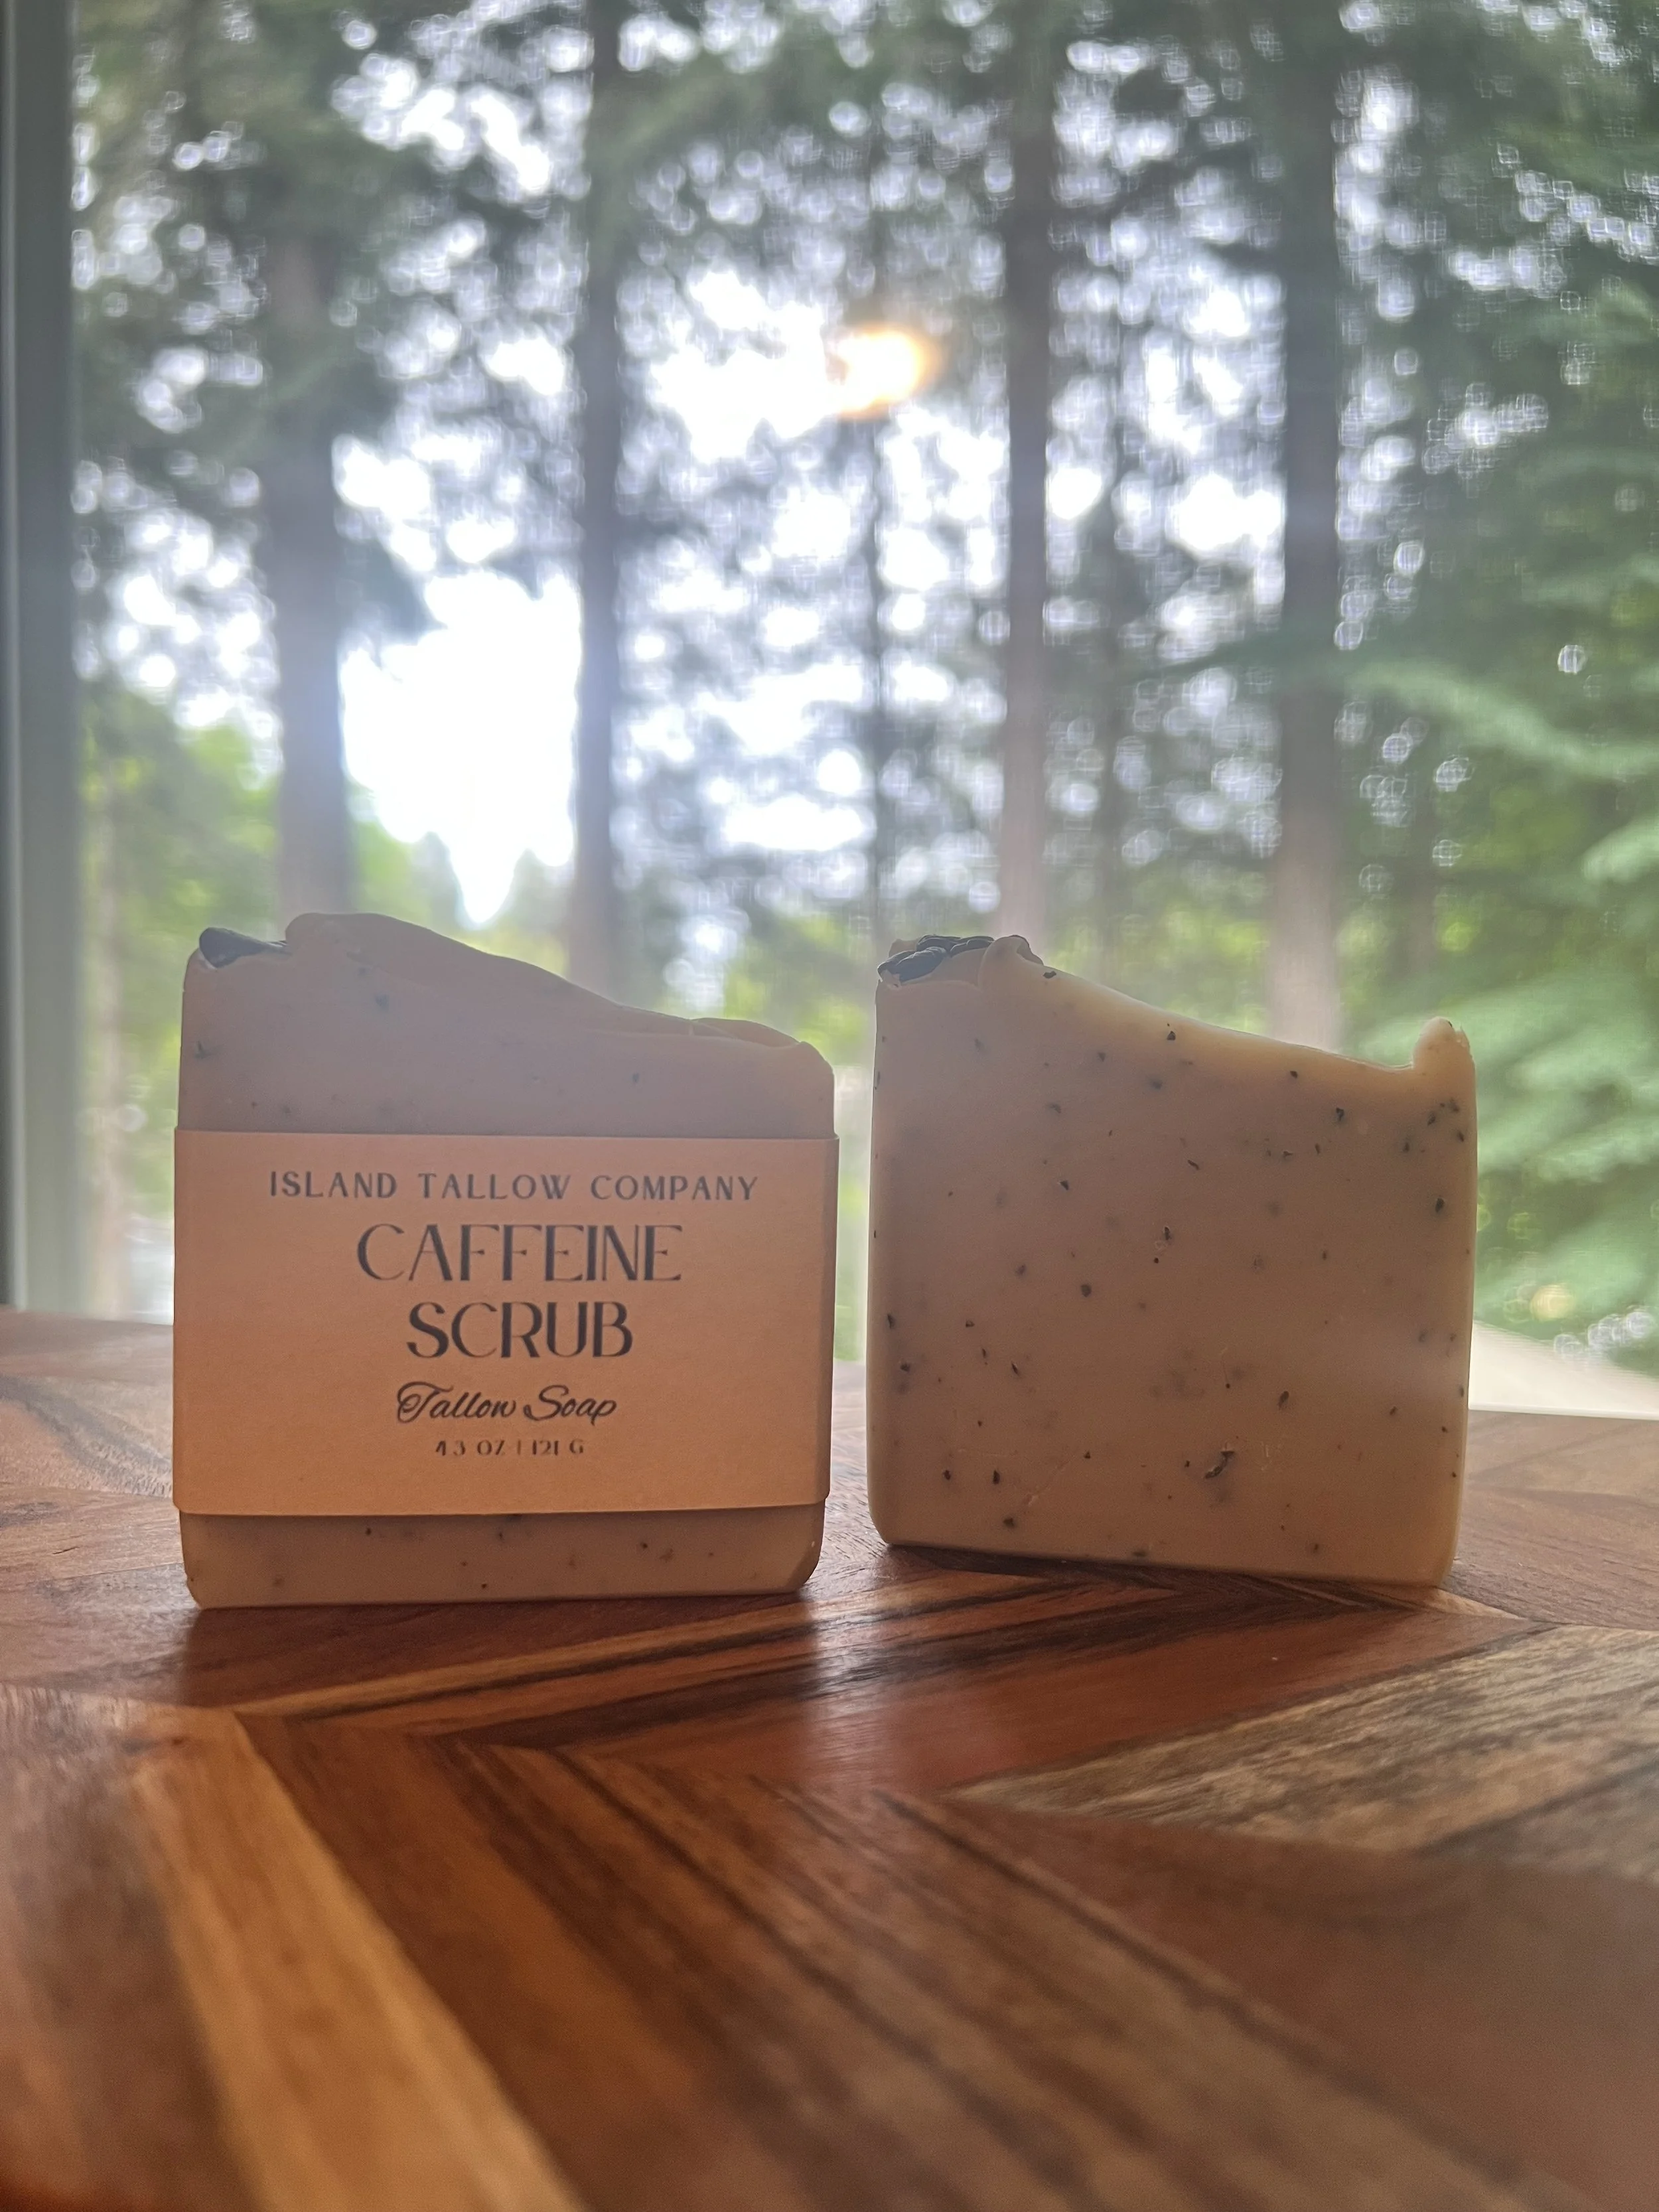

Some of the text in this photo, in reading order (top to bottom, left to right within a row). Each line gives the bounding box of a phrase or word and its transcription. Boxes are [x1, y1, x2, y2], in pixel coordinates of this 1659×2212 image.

[270, 1170, 758, 1201] ISLAND TALLOW COMPANY
[357, 1223, 683, 1282] CAFFEINE
[405, 1301, 634, 1359] SCRUB
[396, 1380, 618, 1426] Tallow Soap
[476, 1439, 506, 1456] OZ
[568, 1438, 585, 1455] G
